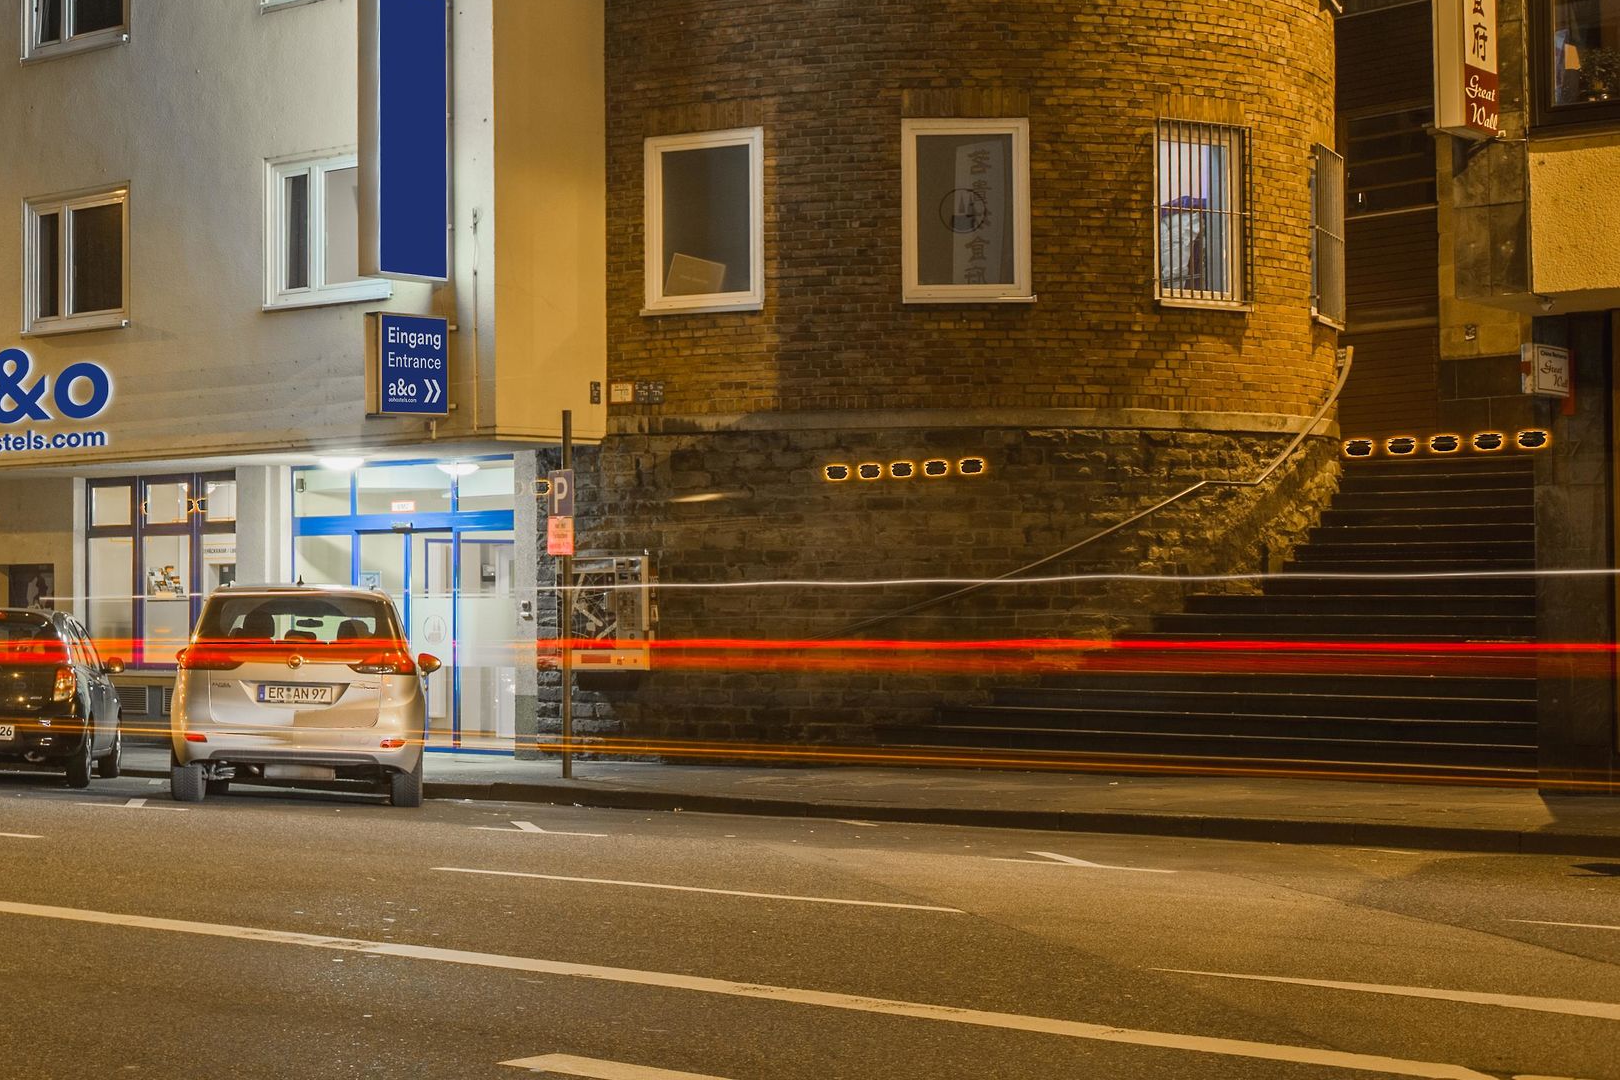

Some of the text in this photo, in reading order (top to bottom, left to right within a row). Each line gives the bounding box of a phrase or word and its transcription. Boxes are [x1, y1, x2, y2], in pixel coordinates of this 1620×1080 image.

[1466, 75, 1496, 102] Great
[1471, 102, 1498, 130] Wall
[388, 327, 441, 350] Eingang
[388, 351, 441, 370] Entrance
[1540, 360, 1562, 374] Great
[388, 378, 417, 397] a&o
[554, 477, 568, 514] P
[269, 686, 326, 700] ER AN 97
